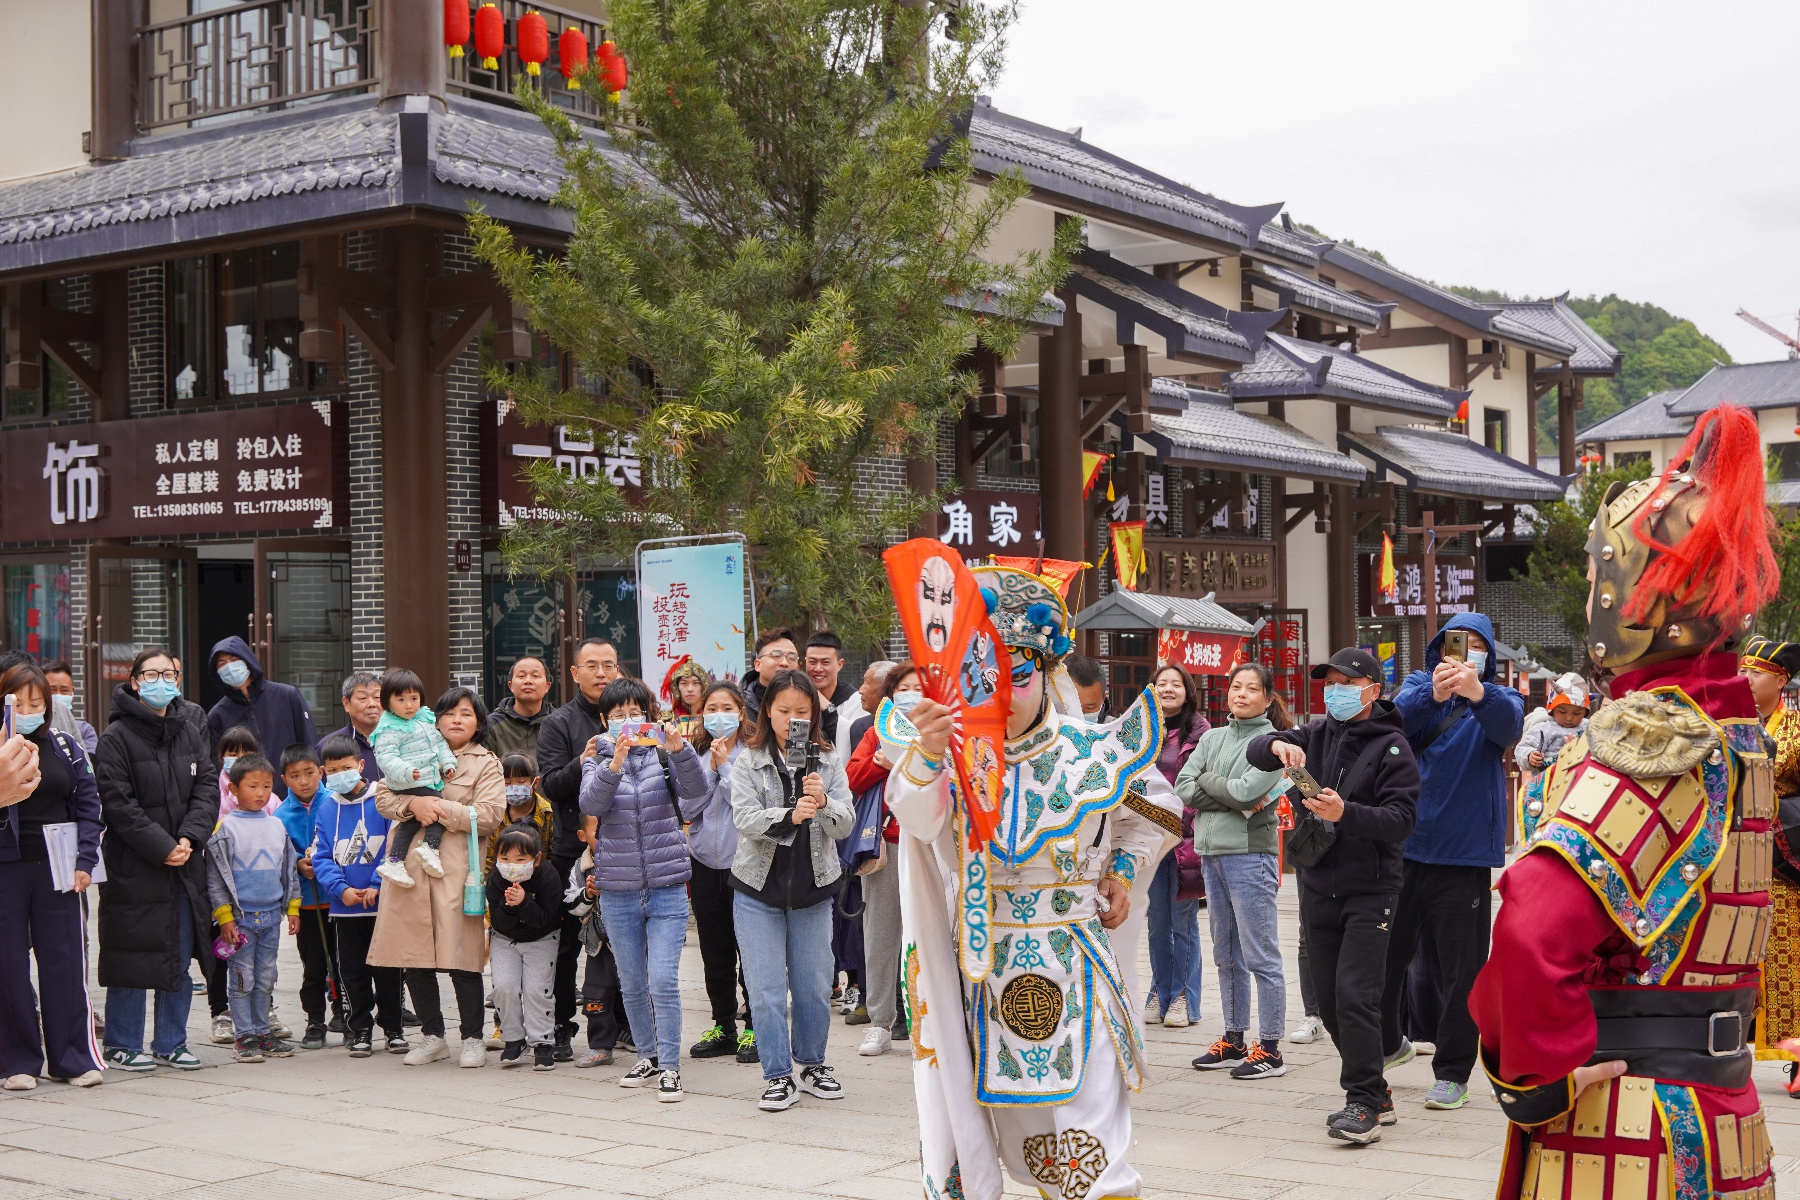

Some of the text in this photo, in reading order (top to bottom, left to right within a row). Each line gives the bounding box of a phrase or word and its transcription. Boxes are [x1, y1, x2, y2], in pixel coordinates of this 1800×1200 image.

[155, 433, 303, 465] 私人定制 拎包入住
[43, 439, 99, 525] 饰
[155, 466, 303, 496] 全屋整装 免费设计
[133, 497, 328, 518] TEL:13508361065 TEL:17784385199
[940, 500, 1042, 547] 角家
[457, 554, 469, 564] 101
[27, 583, 41, 663] 厂家直
[652, 596, 680, 661] 投壶射礼
[669, 582, 690, 643] 玩趣汉唐
[1183, 641, 1222, 668] 火锅奶茶
